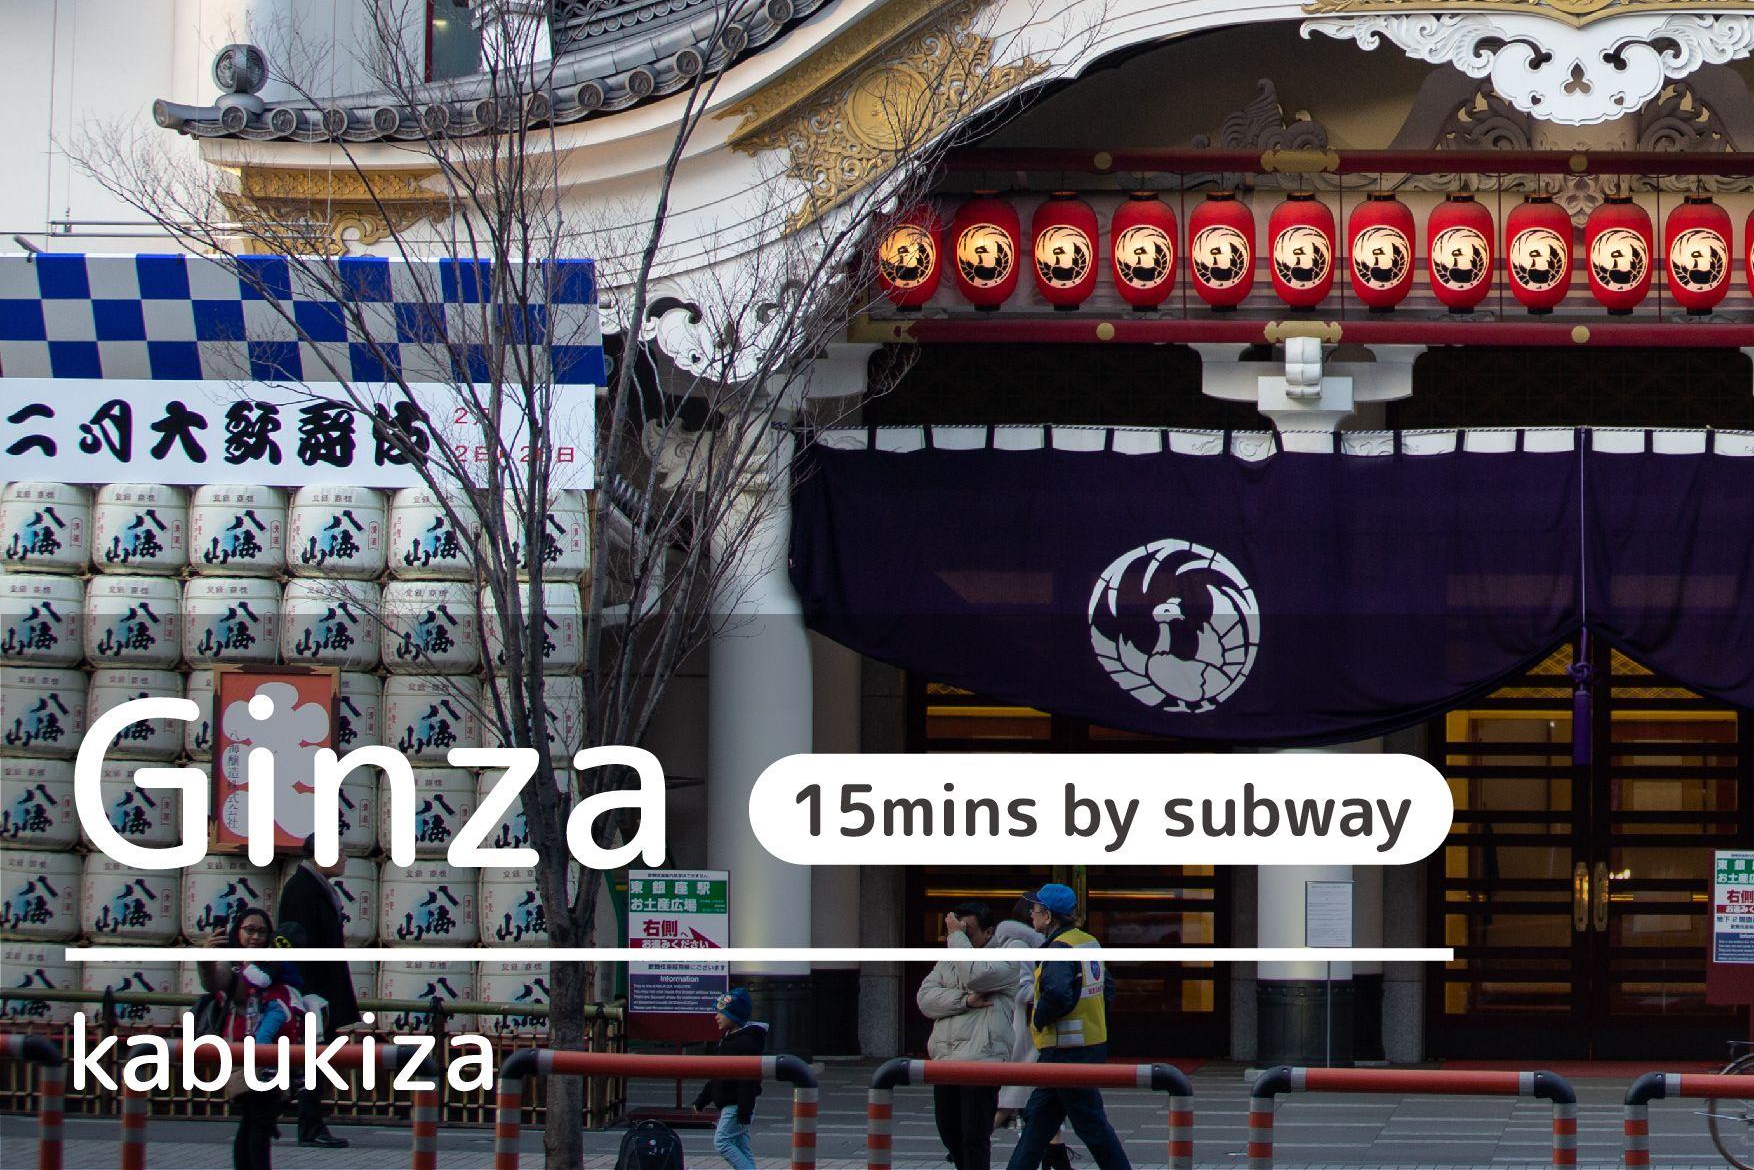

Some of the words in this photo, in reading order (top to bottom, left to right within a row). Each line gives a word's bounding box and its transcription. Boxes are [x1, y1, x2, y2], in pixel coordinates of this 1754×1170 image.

[6, 398, 431, 467] 二月大歌舞伎
[630, 880, 711, 895] 東銀座駅
[630, 897, 697, 912] お土産広場
[660, 975, 700, 983] Information
